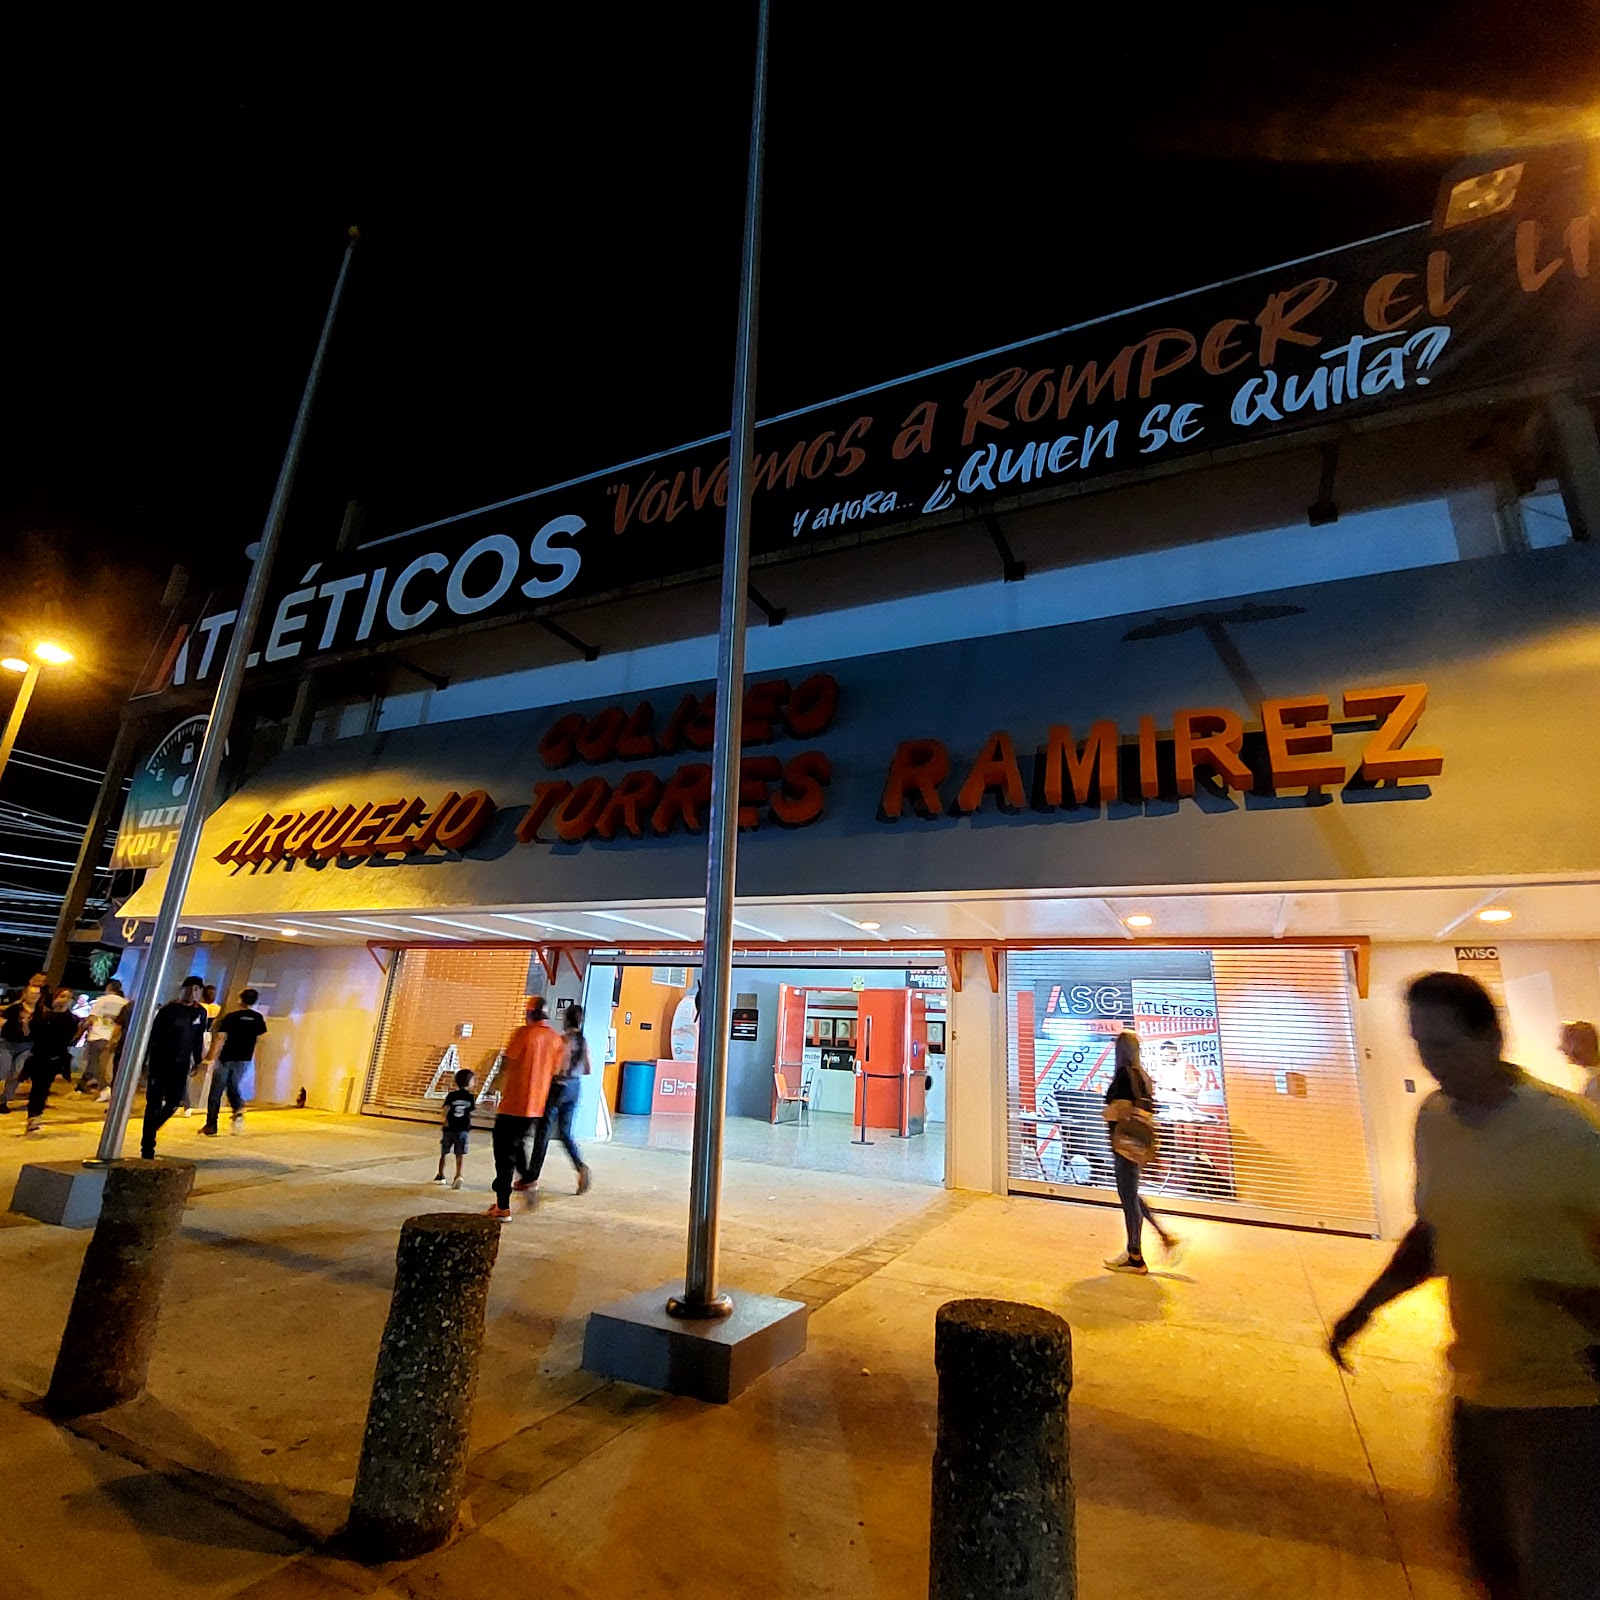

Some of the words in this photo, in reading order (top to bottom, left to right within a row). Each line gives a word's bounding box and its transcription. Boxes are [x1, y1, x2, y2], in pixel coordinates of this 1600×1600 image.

[961, 277, 1338, 445] ROMPER
[1363, 250, 1472, 333] EL
[1139, 403, 1205, 453] SE
[151, 514, 587, 691] ATÉTICOS
[213, 790, 498, 864] ARQUELIO
[514, 751, 832, 843] TORRES
[876, 683, 1444, 819] RAMIREZ
[117, 832, 161, 858] TOP
[1458, 948, 1498, 960] AVISO
[1046, 985, 1123, 1016] ASG
